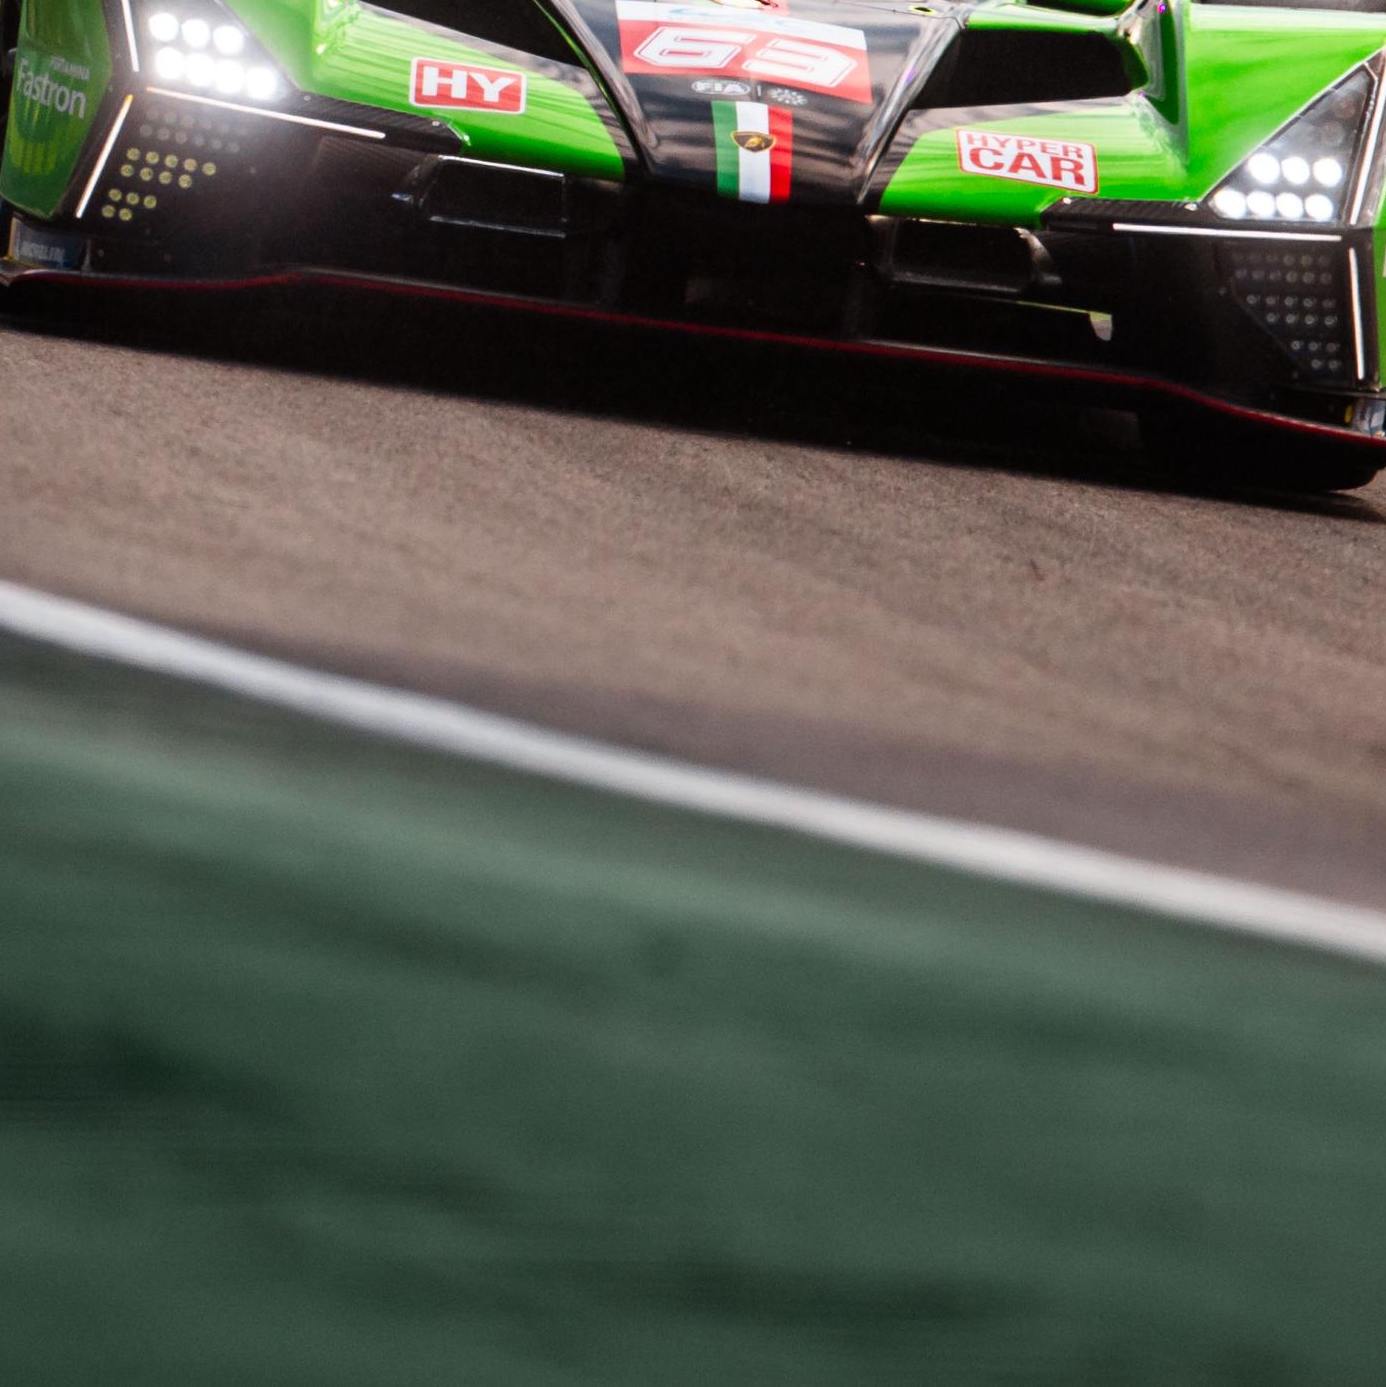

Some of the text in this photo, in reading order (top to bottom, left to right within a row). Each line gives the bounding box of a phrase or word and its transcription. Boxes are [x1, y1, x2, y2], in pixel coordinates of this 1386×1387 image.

[633, 26, 858, 88] 63
[16, 57, 86, 119] Fastron
[422, 66, 518, 103] HY
[694, 80, 747, 95] FIA
[967, 133, 1084, 159] HYPER
[969, 147, 1086, 186] CAR
